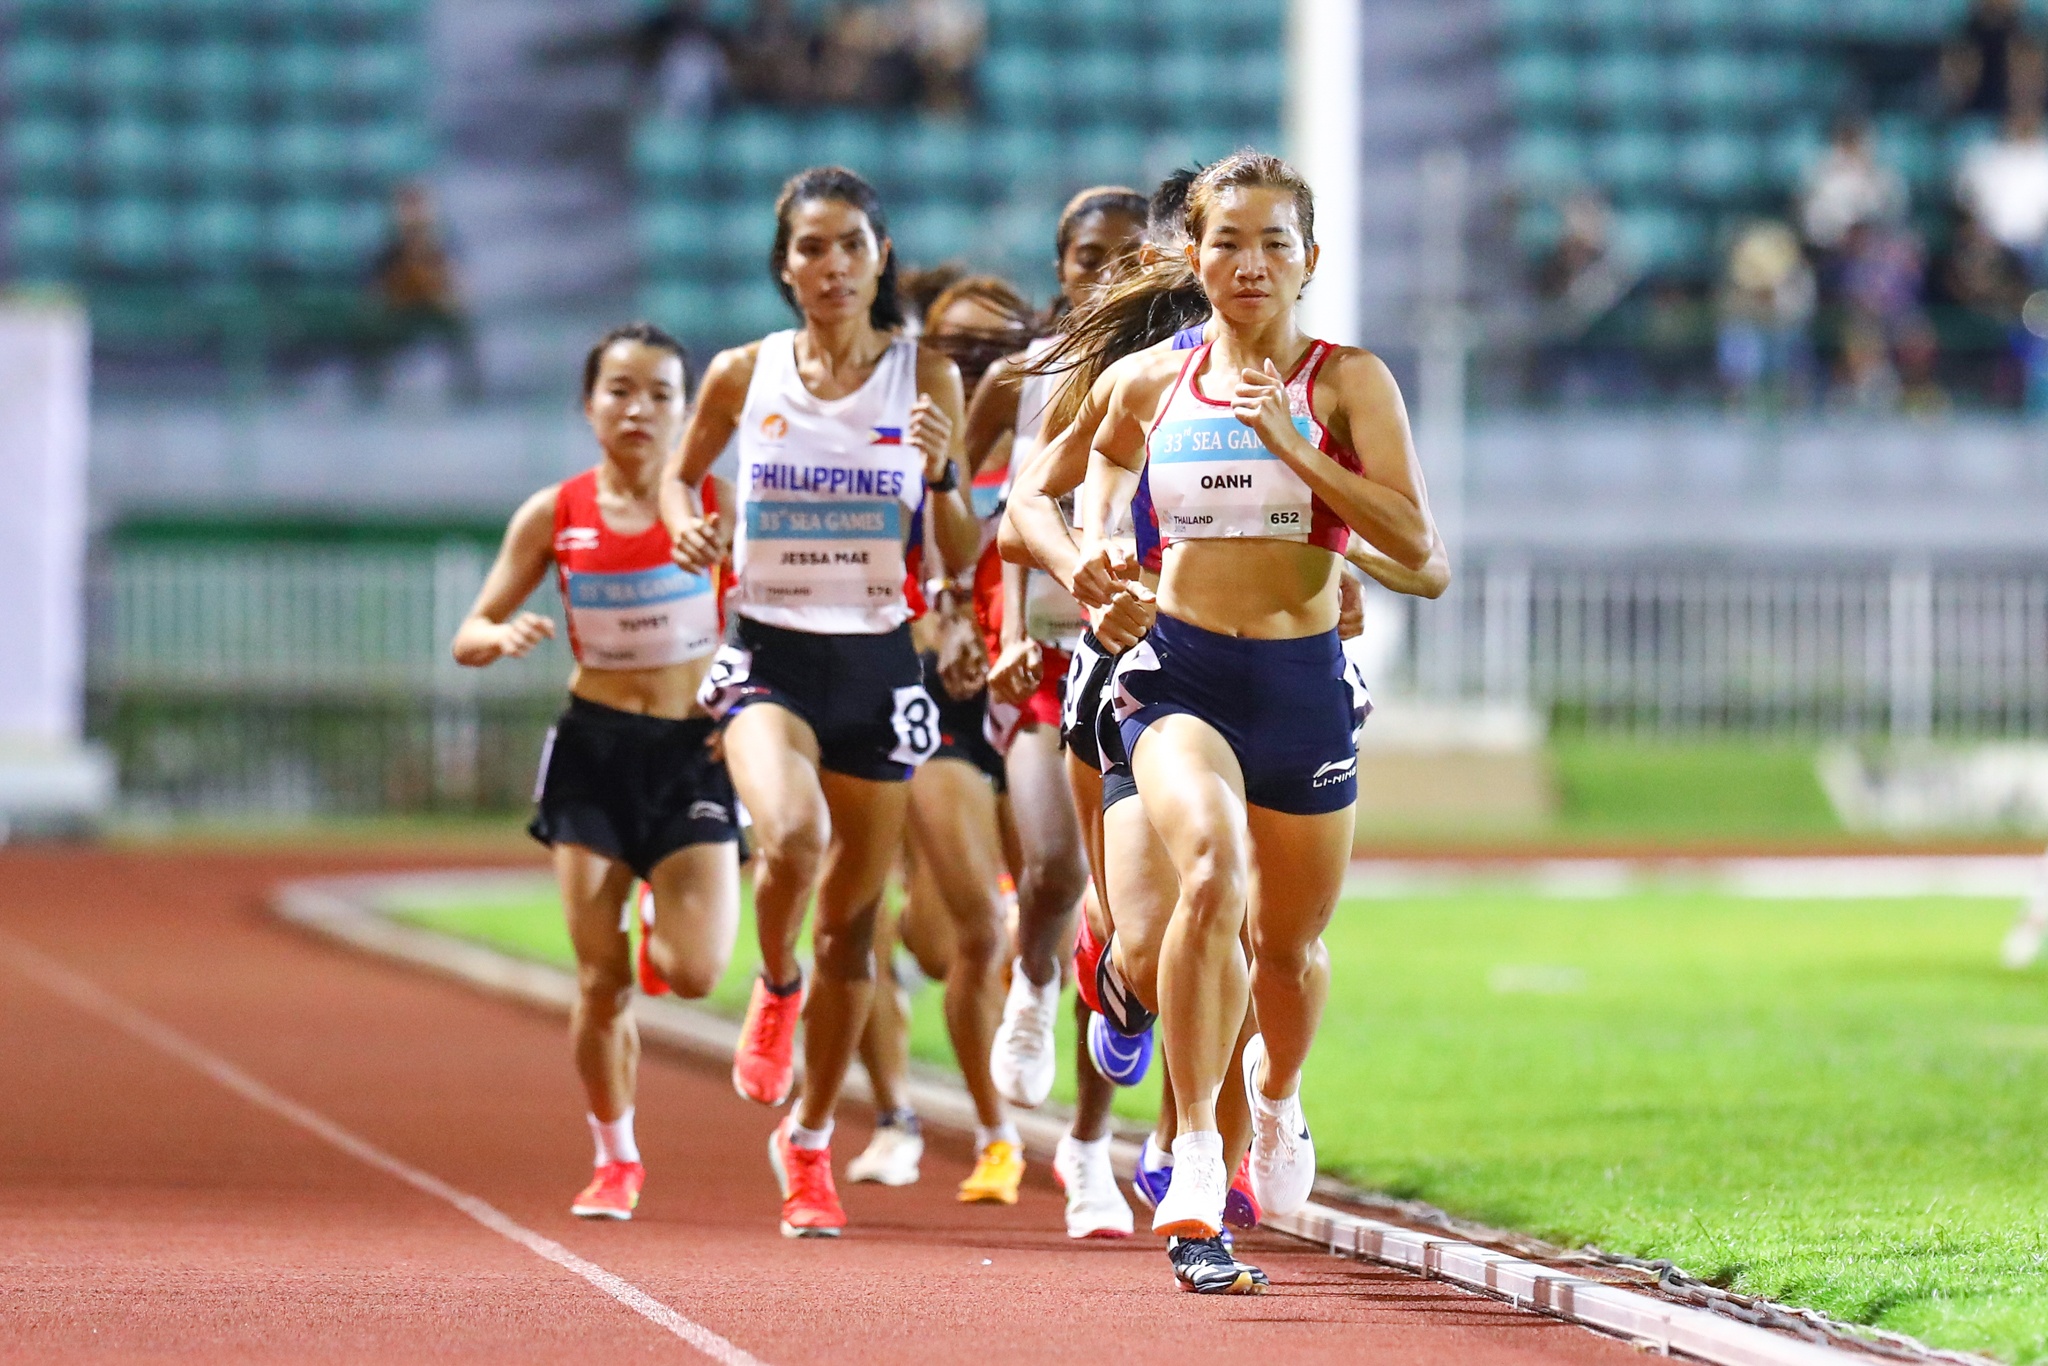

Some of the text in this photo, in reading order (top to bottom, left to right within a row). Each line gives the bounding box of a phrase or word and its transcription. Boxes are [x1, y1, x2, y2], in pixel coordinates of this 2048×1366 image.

[1192, 430, 1223, 451] SEA
[1228, 429, 1267, 450] GAM
[752, 463, 905, 497] PHILIPPINES
[1201, 474, 1252, 489] OANH
[1174, 516, 1214, 525] THAILAND
[1270, 512, 1300, 525] 652
[782, 551, 870, 566] JESSA MAE
[903, 697, 931, 754] 8
[1313, 767, 1357, 787] LI-NING
